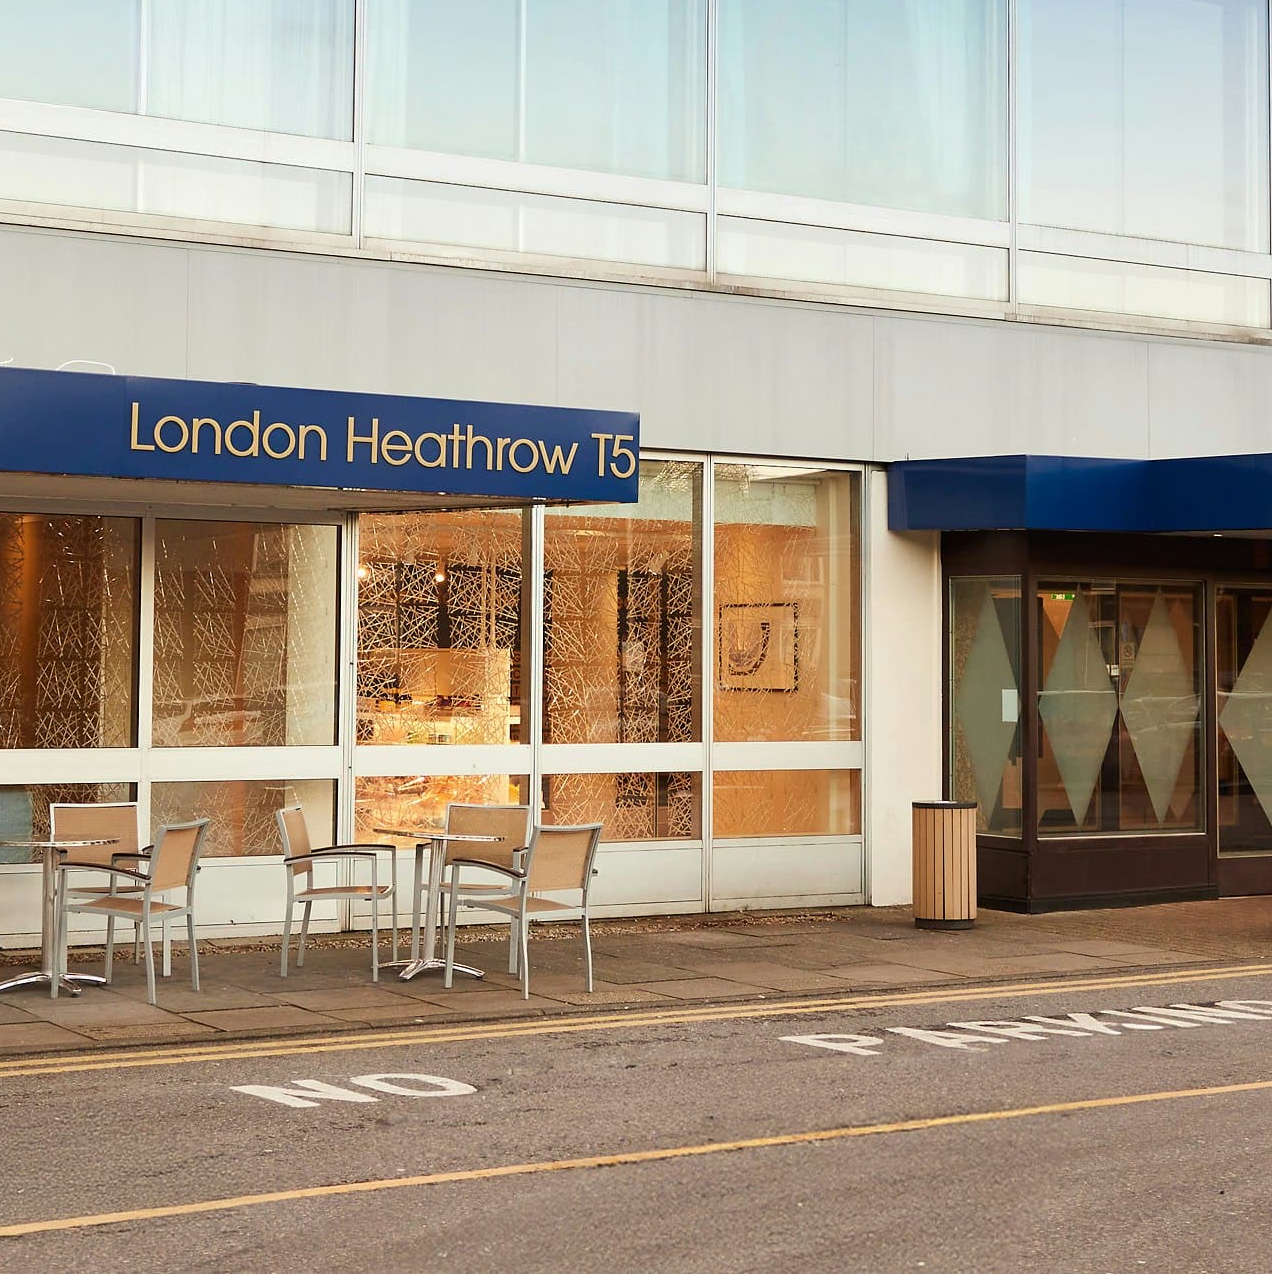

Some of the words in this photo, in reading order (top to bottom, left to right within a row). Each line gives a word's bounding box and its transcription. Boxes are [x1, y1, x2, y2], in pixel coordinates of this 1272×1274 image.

[130, 402, 327, 461] London
[346, 417, 578, 475] Heathrow
[590, 432, 637, 479] T5
[229, 1073, 478, 1108] NO
